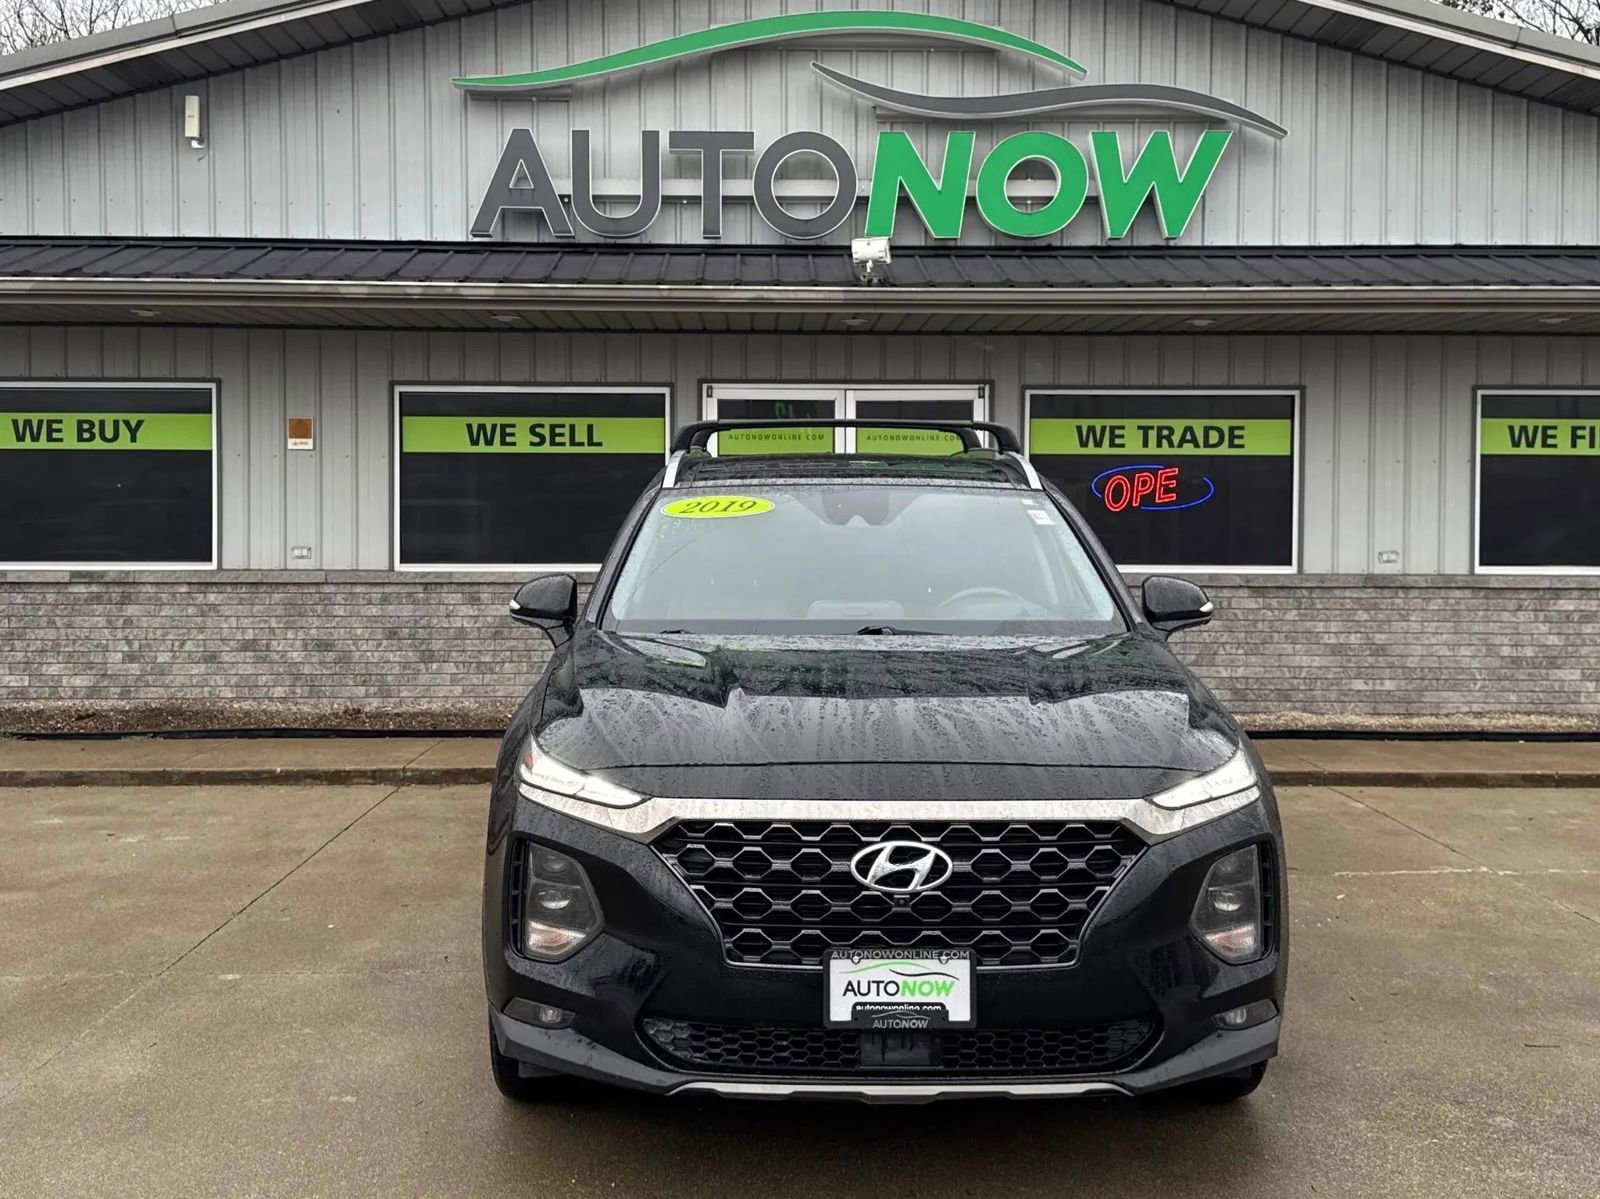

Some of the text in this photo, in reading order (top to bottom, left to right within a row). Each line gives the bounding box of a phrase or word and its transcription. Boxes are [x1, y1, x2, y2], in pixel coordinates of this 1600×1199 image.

[11, 418, 145, 443] WE BUY
[465, 423, 603, 447] WE SELL
[1076, 425, 1245, 449] WE TRADE
[1507, 425, 1600, 449] WE FI
[1104, 467, 1179, 512] OPE
[679, 500, 758, 514] 2019
[842, 980, 955, 997] AUTONOW
[872, 1019, 929, 1029] AUTONOW
